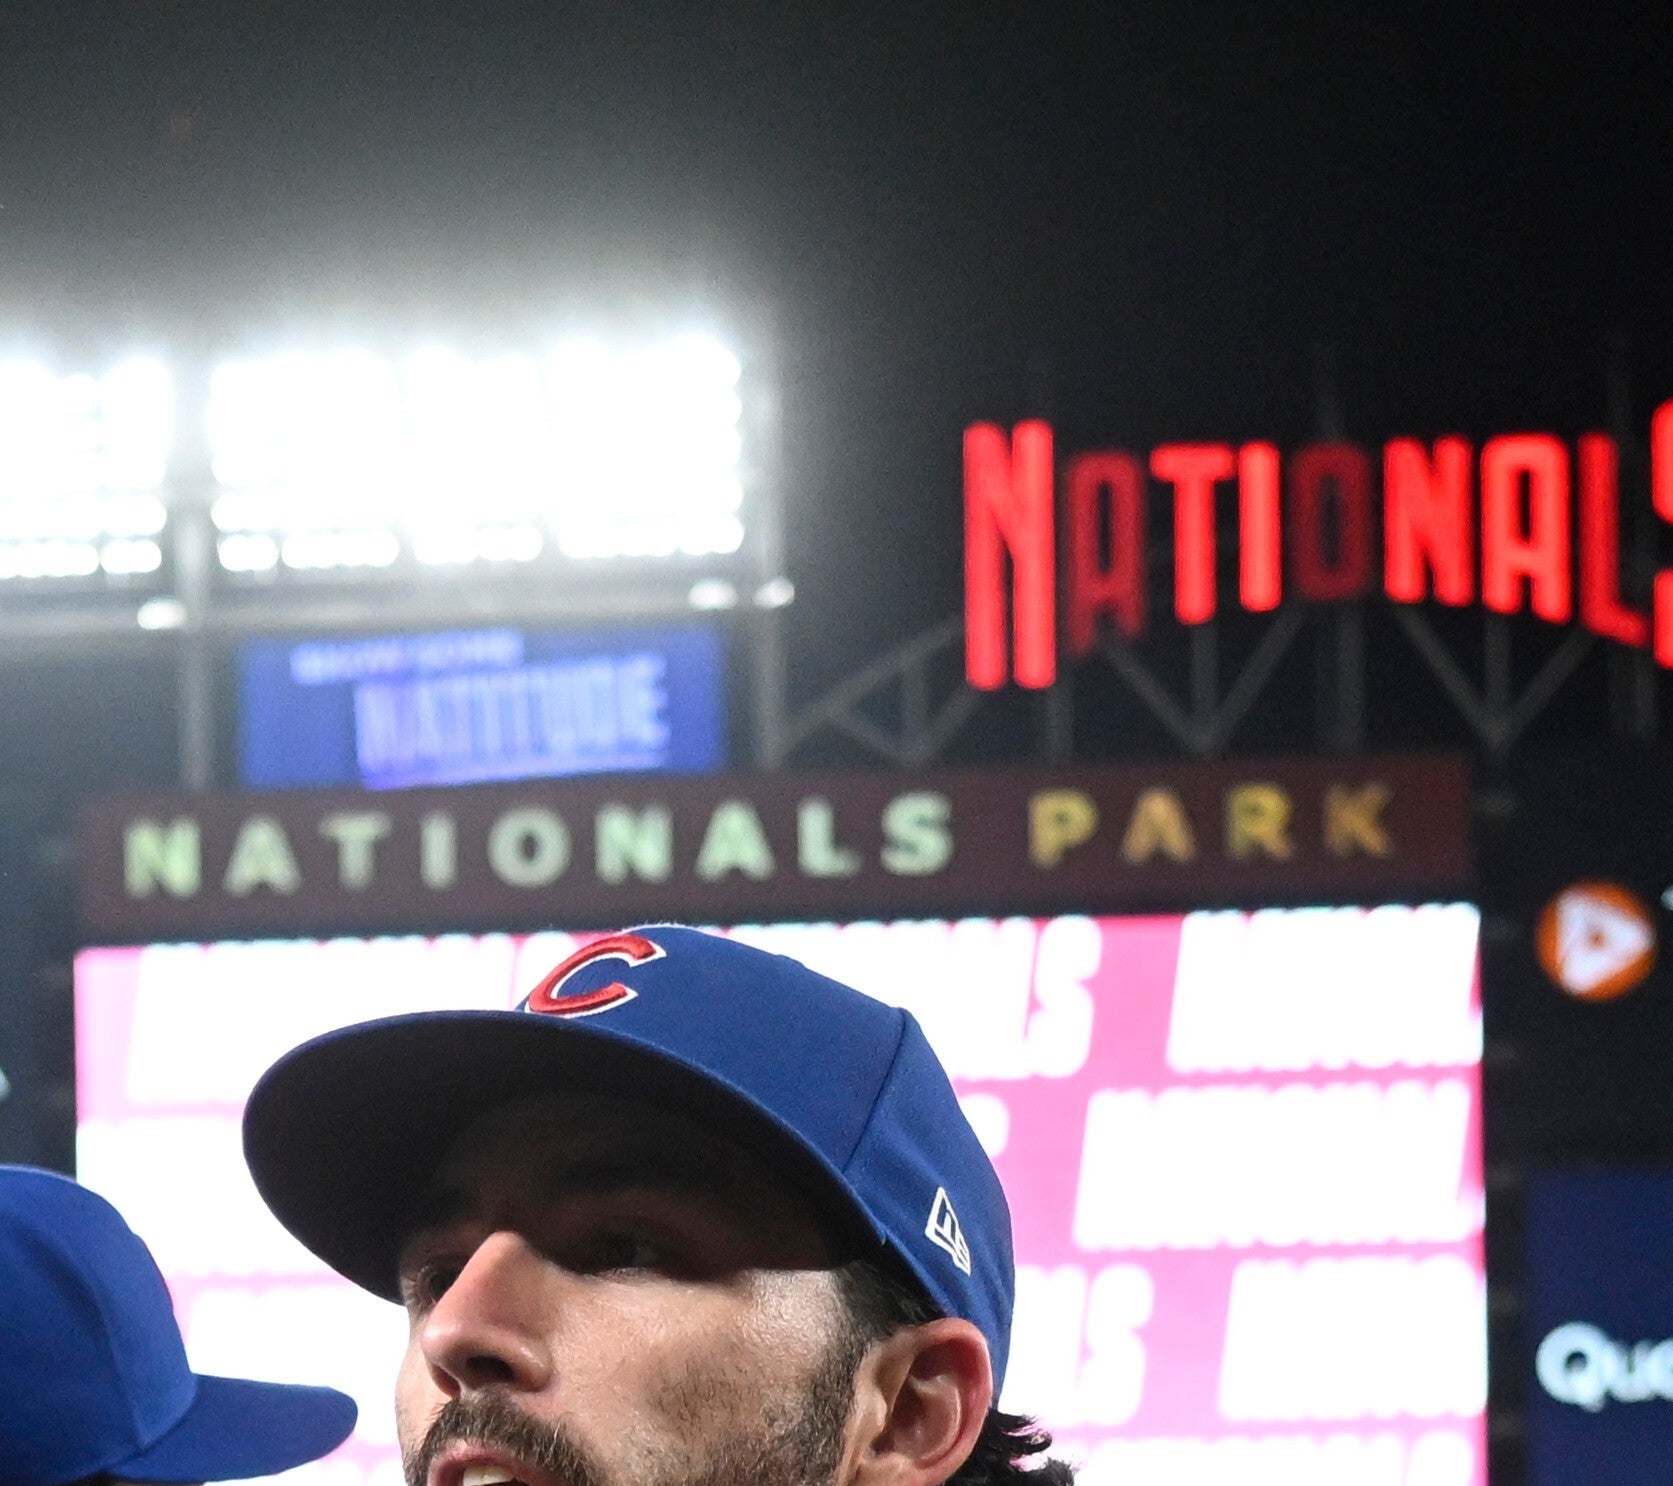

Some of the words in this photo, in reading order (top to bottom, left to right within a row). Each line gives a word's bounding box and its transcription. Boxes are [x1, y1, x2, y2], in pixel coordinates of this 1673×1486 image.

[123, 793, 954, 898] NATIONALS
[1028, 784, 1392, 864] PARK
[524, 931, 667, 1019] C
